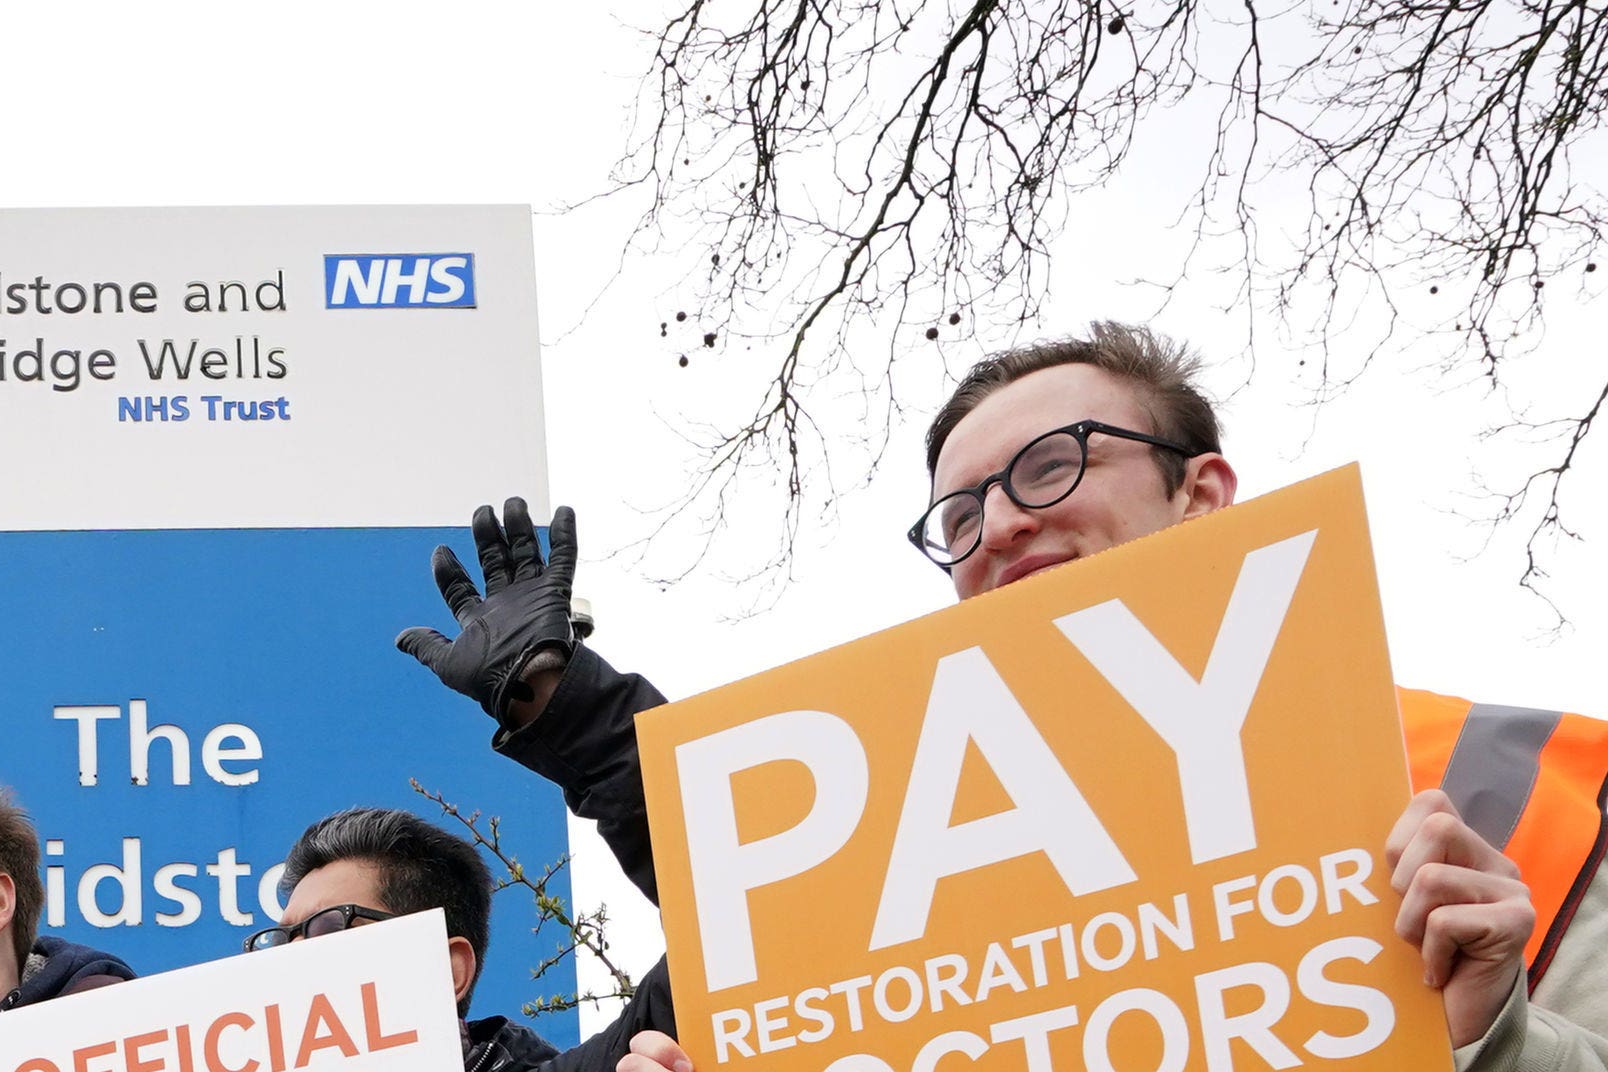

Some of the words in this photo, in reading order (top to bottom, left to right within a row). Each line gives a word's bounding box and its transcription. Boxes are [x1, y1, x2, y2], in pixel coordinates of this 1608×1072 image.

[183, 270, 287, 312] and
[331, 255, 466, 306] NHS
[137, 336, 288, 380] Wells
[118, 396, 190, 422] NHS
[200, 396, 291, 422] Trust
[52, 698, 264, 787] The
[673, 528, 1319, 994] PAY
[711, 893, 1194, 1064] RESTORATION
[1212, 847, 1380, 942] FOR
